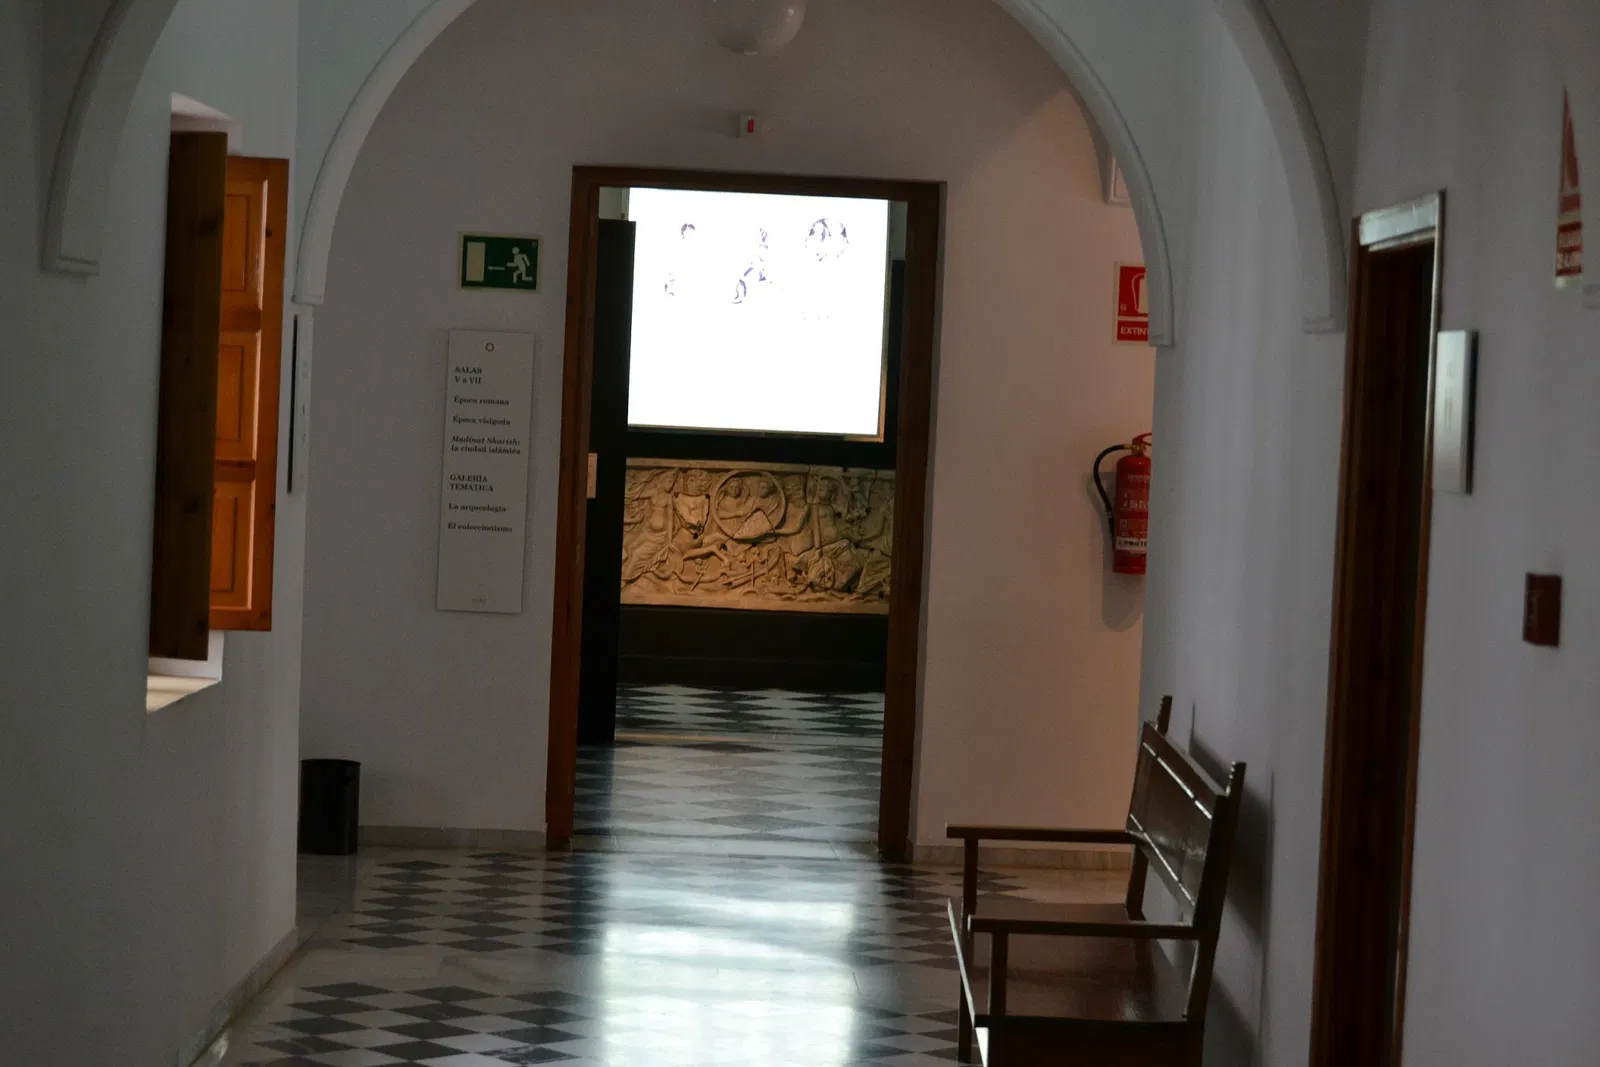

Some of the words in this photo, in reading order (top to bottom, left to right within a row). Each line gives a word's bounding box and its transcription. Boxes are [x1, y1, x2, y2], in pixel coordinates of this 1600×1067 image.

[454, 366, 483, 374] SALAS
[469, 376, 482, 385] VII
[479, 398, 510, 406] romana
[478, 416, 511, 426] visigoda
[451, 444, 459, 452] la
[460, 445, 487, 453] ciudad
[448, 502, 459, 510] La
[447, 522, 456, 530] El
[457, 523, 513, 532] coleccionismo
